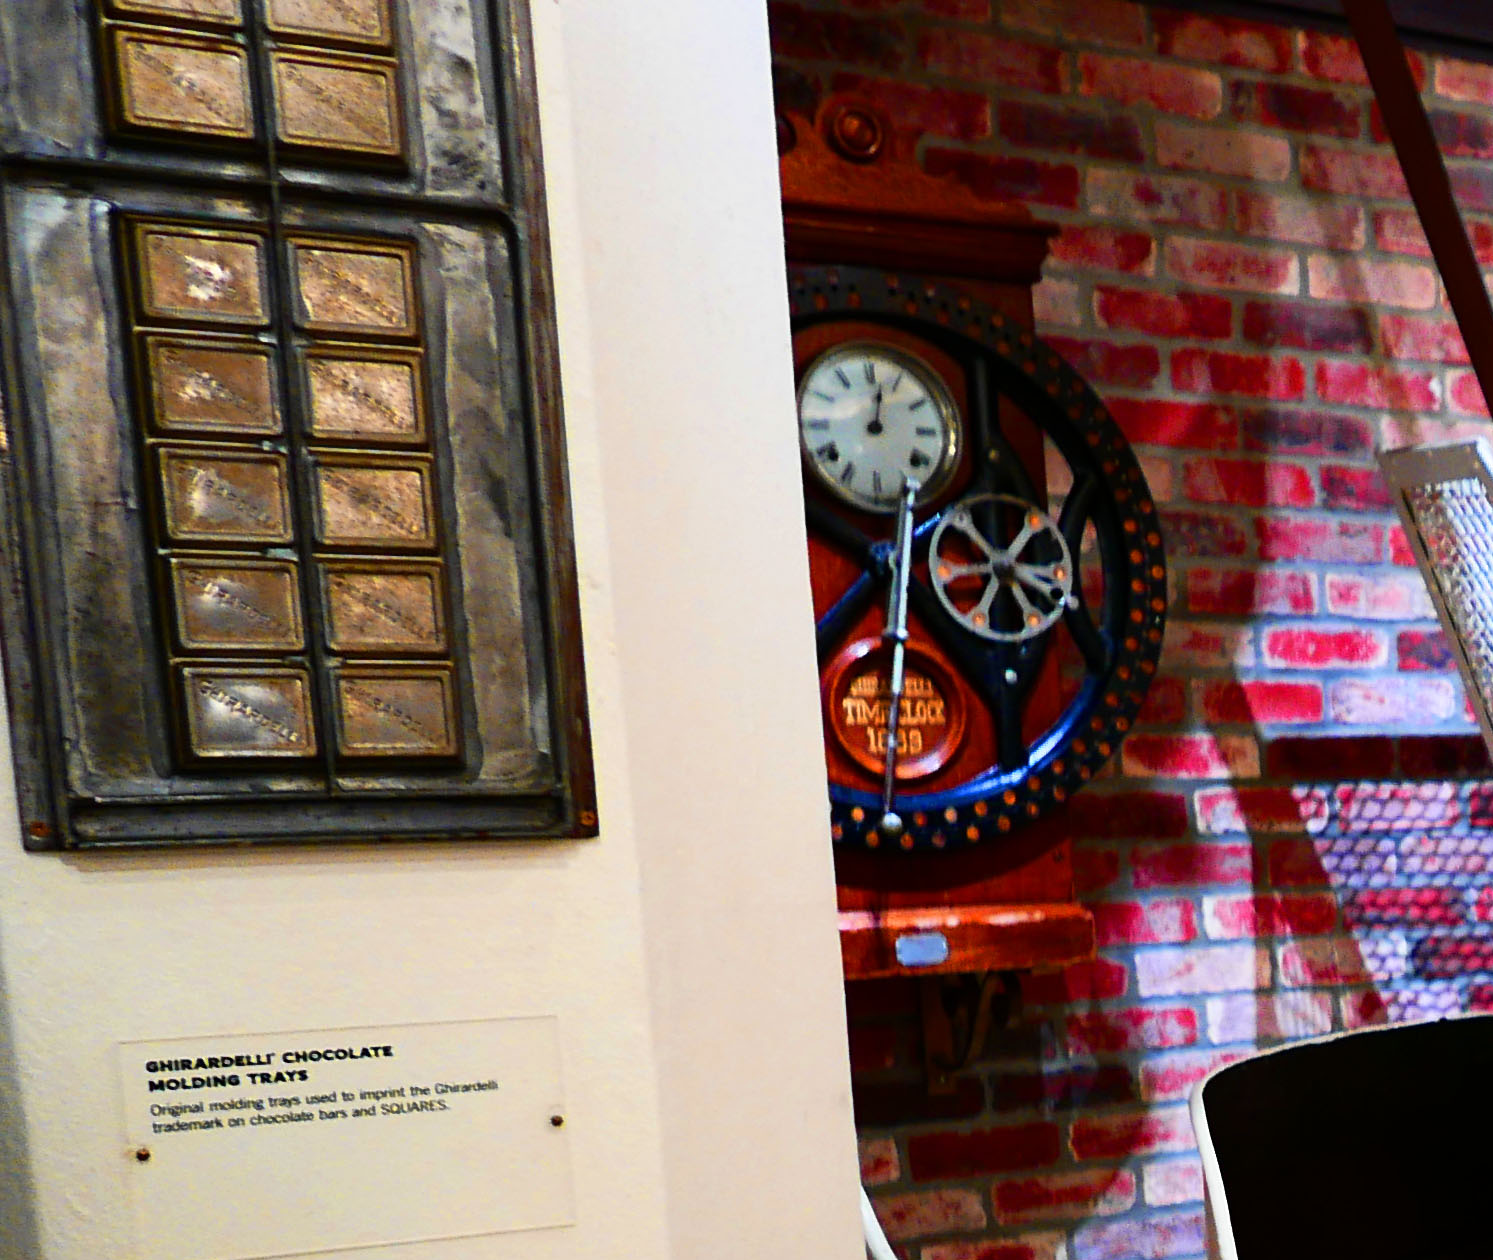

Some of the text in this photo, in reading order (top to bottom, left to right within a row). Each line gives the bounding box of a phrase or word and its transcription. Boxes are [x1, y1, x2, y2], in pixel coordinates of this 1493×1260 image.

[281, 1046, 394, 1064] CHOCOLATE
[148, 1070, 309, 1092] MOLDING TRAYS
[150, 1079, 499, 1117] Original molding trays used to imprint the Ghirardelli
[152, 1099, 450, 1134] trademark on chocolate bars and SQUARES.
